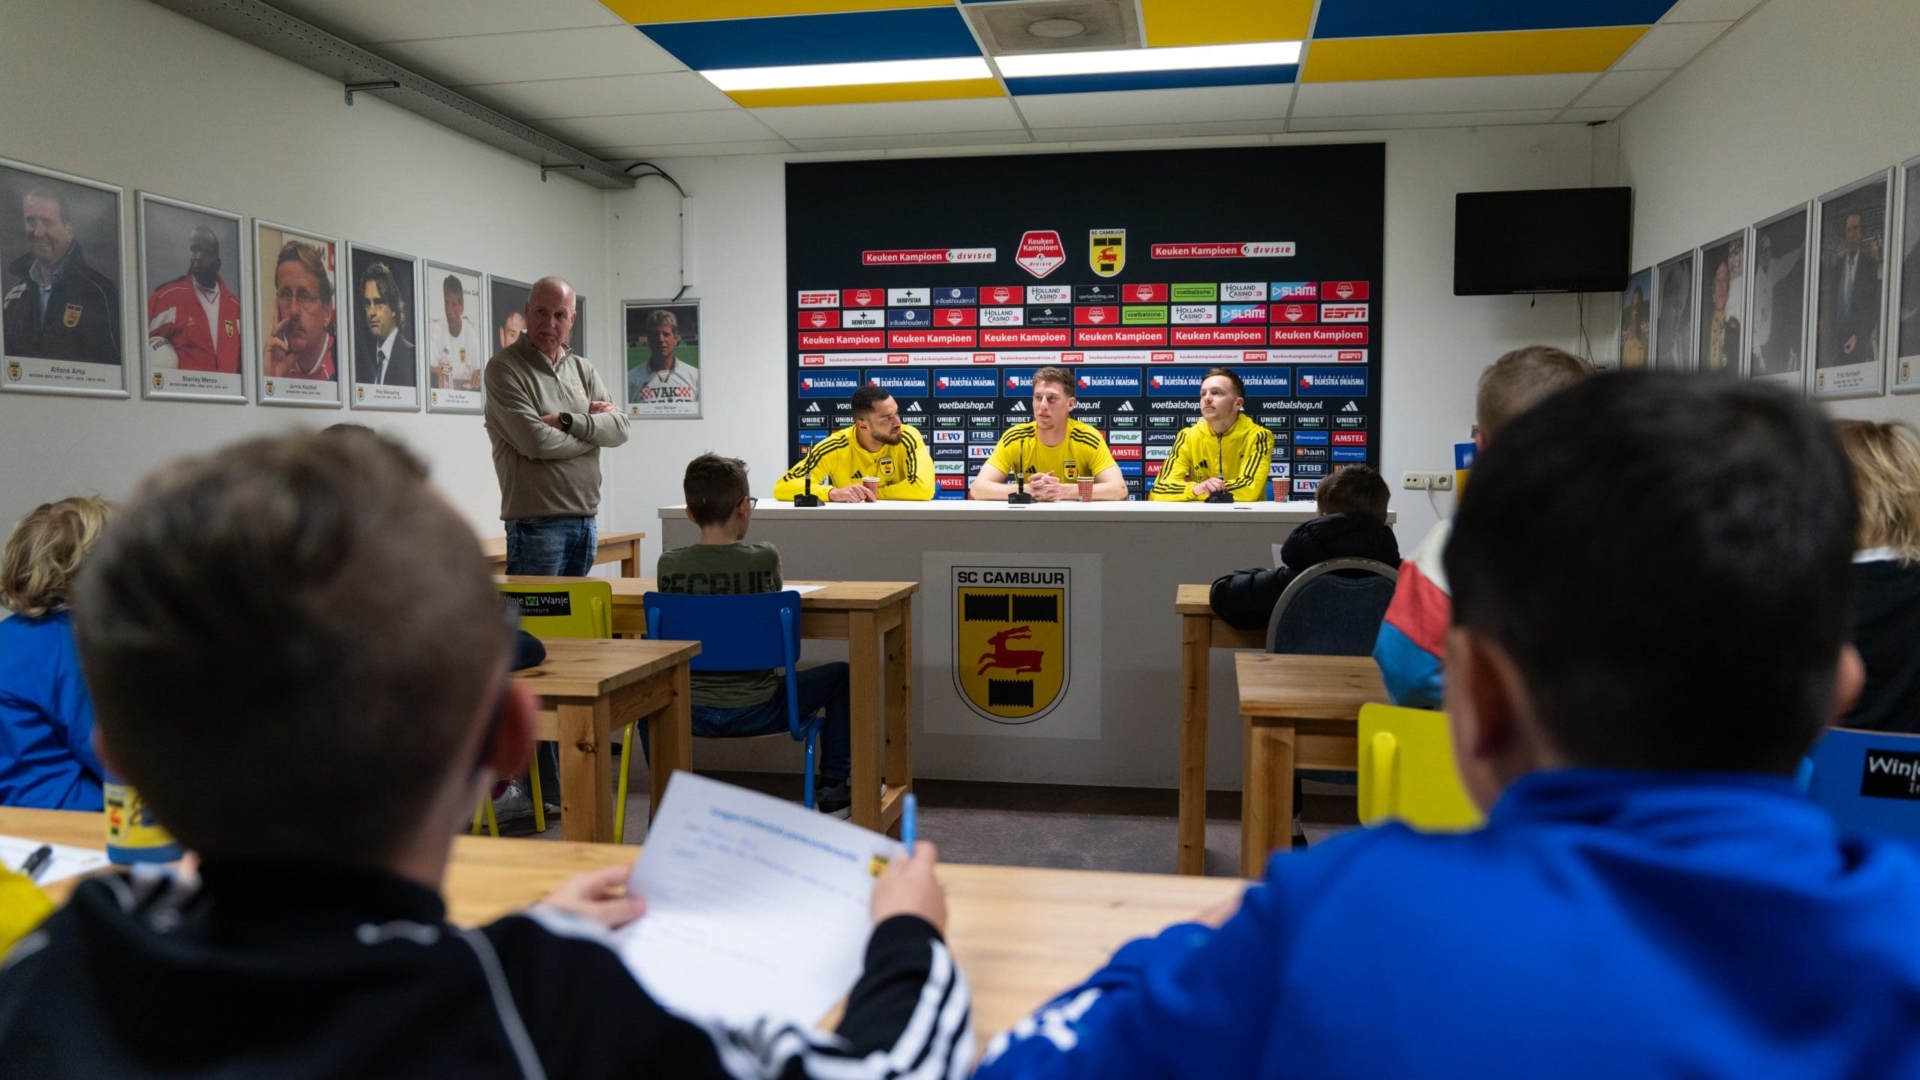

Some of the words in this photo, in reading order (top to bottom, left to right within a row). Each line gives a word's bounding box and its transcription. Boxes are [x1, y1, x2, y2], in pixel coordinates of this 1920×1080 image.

[1023, 244, 1058, 252] Kampioen
[1156, 247, 1189, 255] Keuken
[1191, 246, 1237, 256] Kampioen
[1253, 245, 1291, 254] divisie
[867, 253, 897, 262] Keuken
[900, 252, 942, 262] Kampioen
[957, 252, 992, 260] divisie
[1225, 284, 1256, 292] HOLLAND
[1282, 286, 1316, 296] SLAM!
[801, 293, 838, 304] ESPN
[1034, 293, 1057, 301] CASINO
[984, 309, 1013, 317] HOLLAND
[1179, 313, 1203, 321] CASINO
[1231, 309, 1266, 319] SLAM!
[1324, 307, 1366, 319] ESPN
[988, 315, 1010, 323] CASINO
[803, 336, 834, 344] Keuken
[836, 335, 880, 345] Kampioen
[892, 334, 925, 343] Keuken
[927, 334, 972, 344] Kampioen
[984, 333, 1018, 342] Keuken
[1020, 333, 1066, 343] Kampioen
[1079, 332, 1113, 341] Keuken
[1115, 331, 1162, 342] Kampioen
[1176, 331, 1211, 340] Keuken
[1213, 331, 1262, 341] Kampioen
[1275, 331, 1311, 339] Keuken
[1313, 330, 1363, 341] Kampioen
[652, 387, 679, 398] VAK
[939, 401, 994, 411] voetbalshop.nl
[1151, 401, 1201, 411] voetbalshop.
[1262, 401, 1323, 411] voetbalshop.nl
[1148, 433, 1176, 441] junction
[1304, 448, 1326, 456] haan
[1298, 464, 1322, 472] ITBB
[957, 571, 978, 584] SC
[983, 571, 1065, 585] CAMBUUR
[540, 596, 569, 607] Wanje
